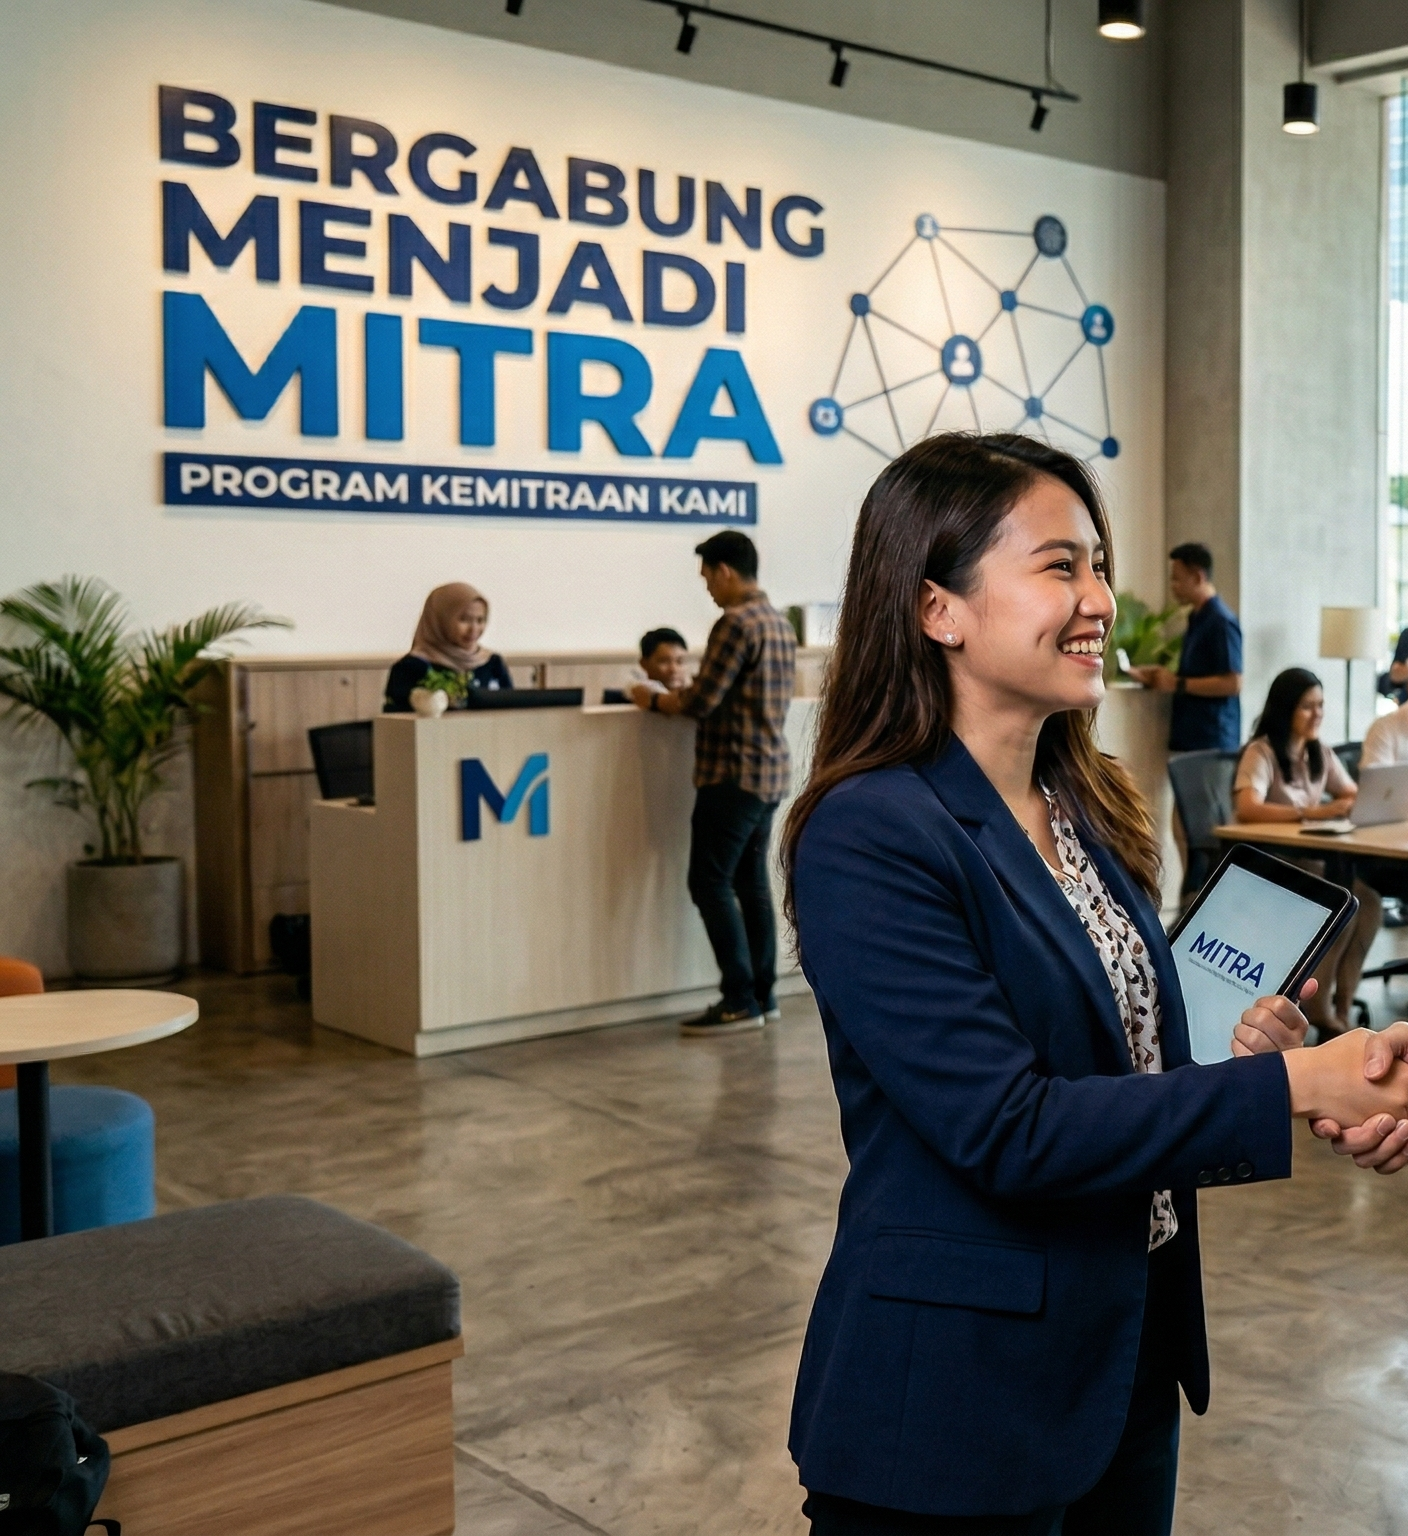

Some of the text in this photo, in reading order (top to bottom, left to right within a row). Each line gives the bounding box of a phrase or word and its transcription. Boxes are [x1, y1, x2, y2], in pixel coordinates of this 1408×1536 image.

[158, 84, 825, 258] BERGABUNG
[160, 180, 747, 334] MENJADI
[161, 290, 785, 465] MITRA
[180, 462, 748, 517] PROGRAM KEMITRAAN KAMI
[460, 752, 551, 841] M
[1188, 931, 1266, 988] MITRA
